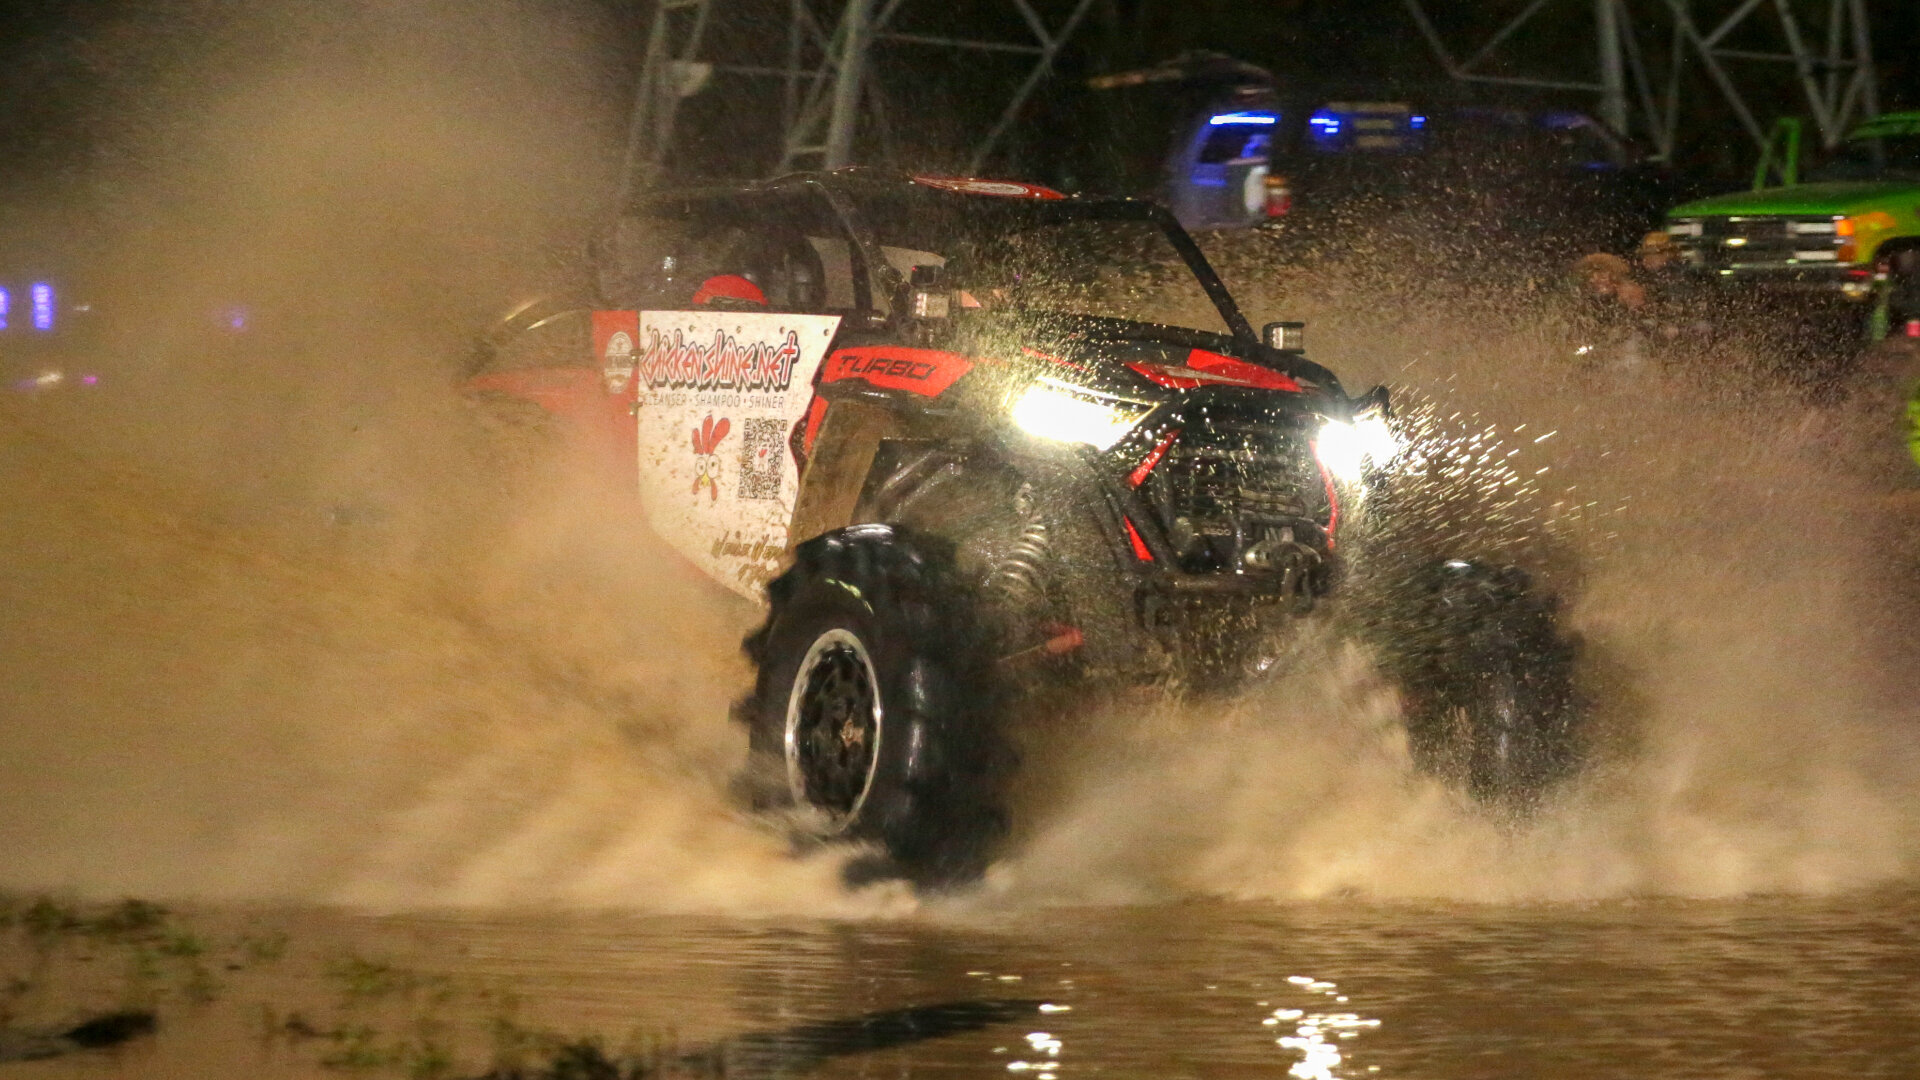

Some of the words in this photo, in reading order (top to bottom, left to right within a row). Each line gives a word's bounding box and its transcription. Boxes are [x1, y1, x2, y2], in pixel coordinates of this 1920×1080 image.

[838, 355, 936, 381] TURBO
[695, 394, 741, 408] SHAMPOO
[749, 395, 784, 409] SHINER
